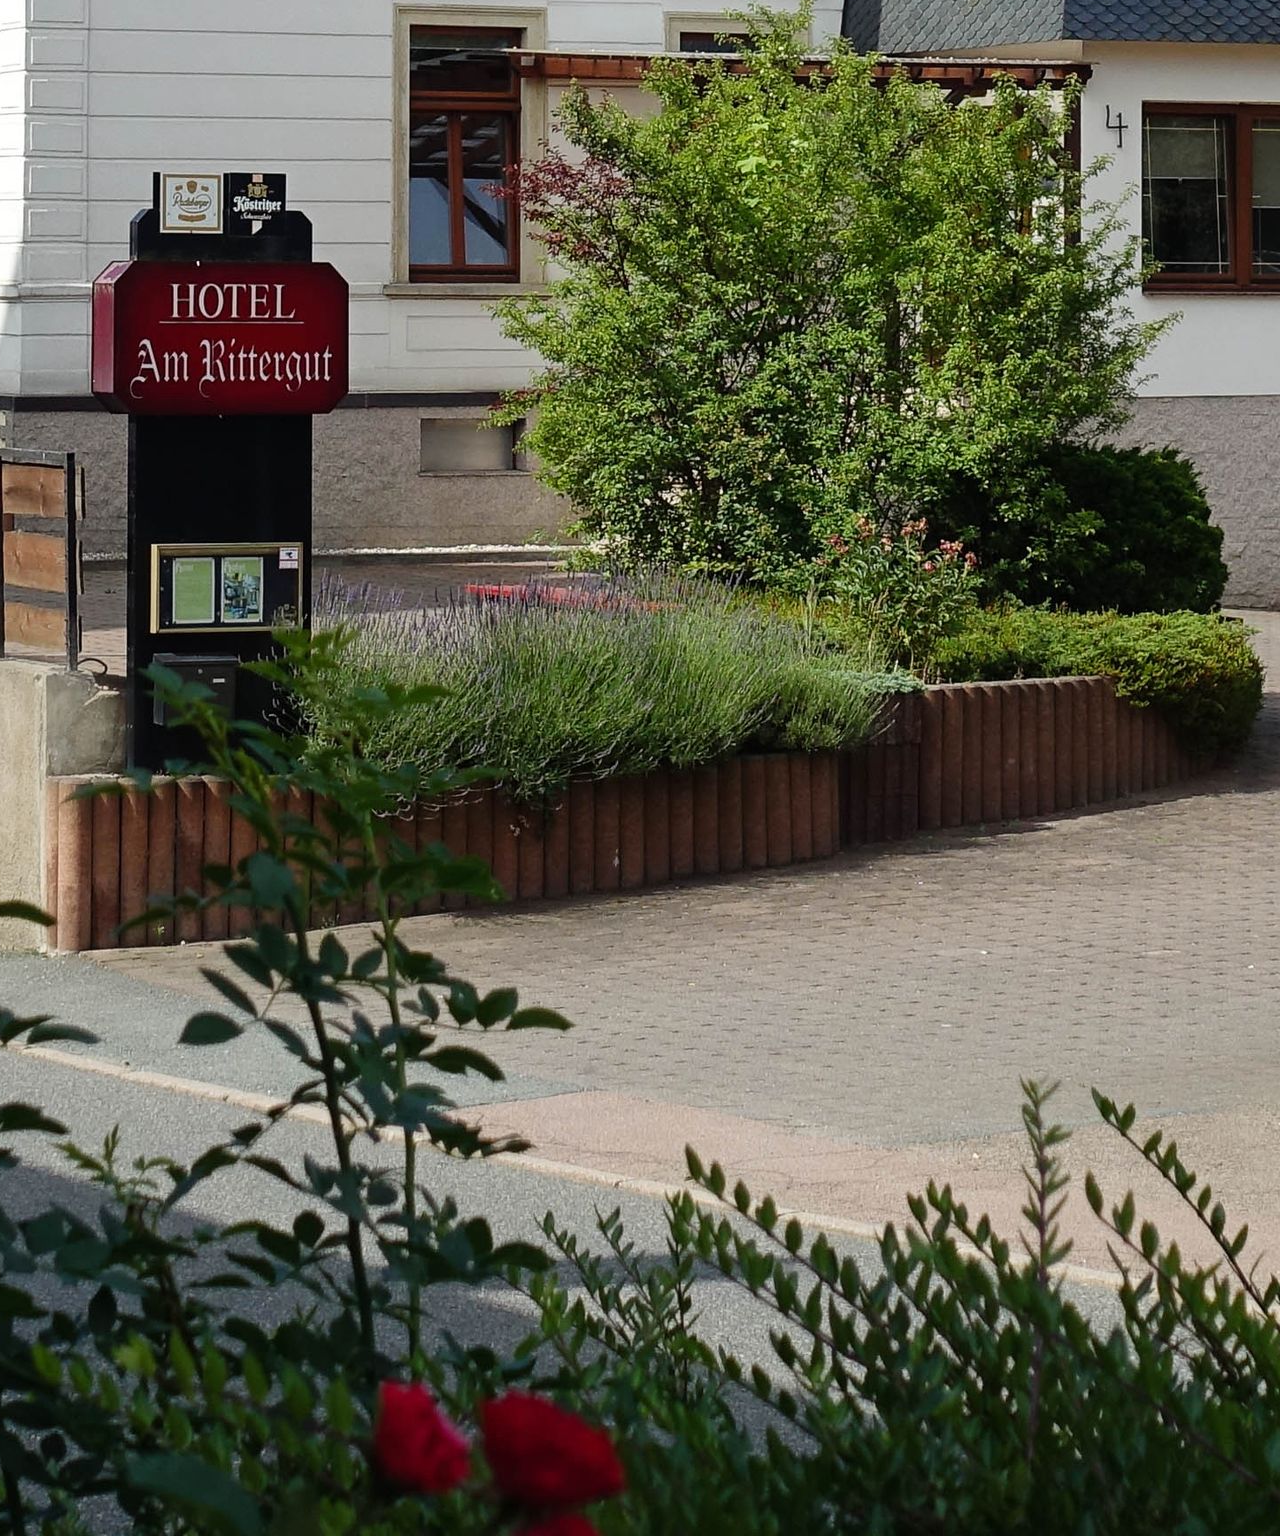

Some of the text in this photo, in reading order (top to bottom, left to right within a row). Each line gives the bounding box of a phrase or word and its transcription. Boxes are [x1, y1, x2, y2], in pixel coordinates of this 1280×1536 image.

[1105, 104, 1129, 149] 4
[169, 283, 297, 320] HOTEL
[129, 338, 333, 400] Am Rittergut
